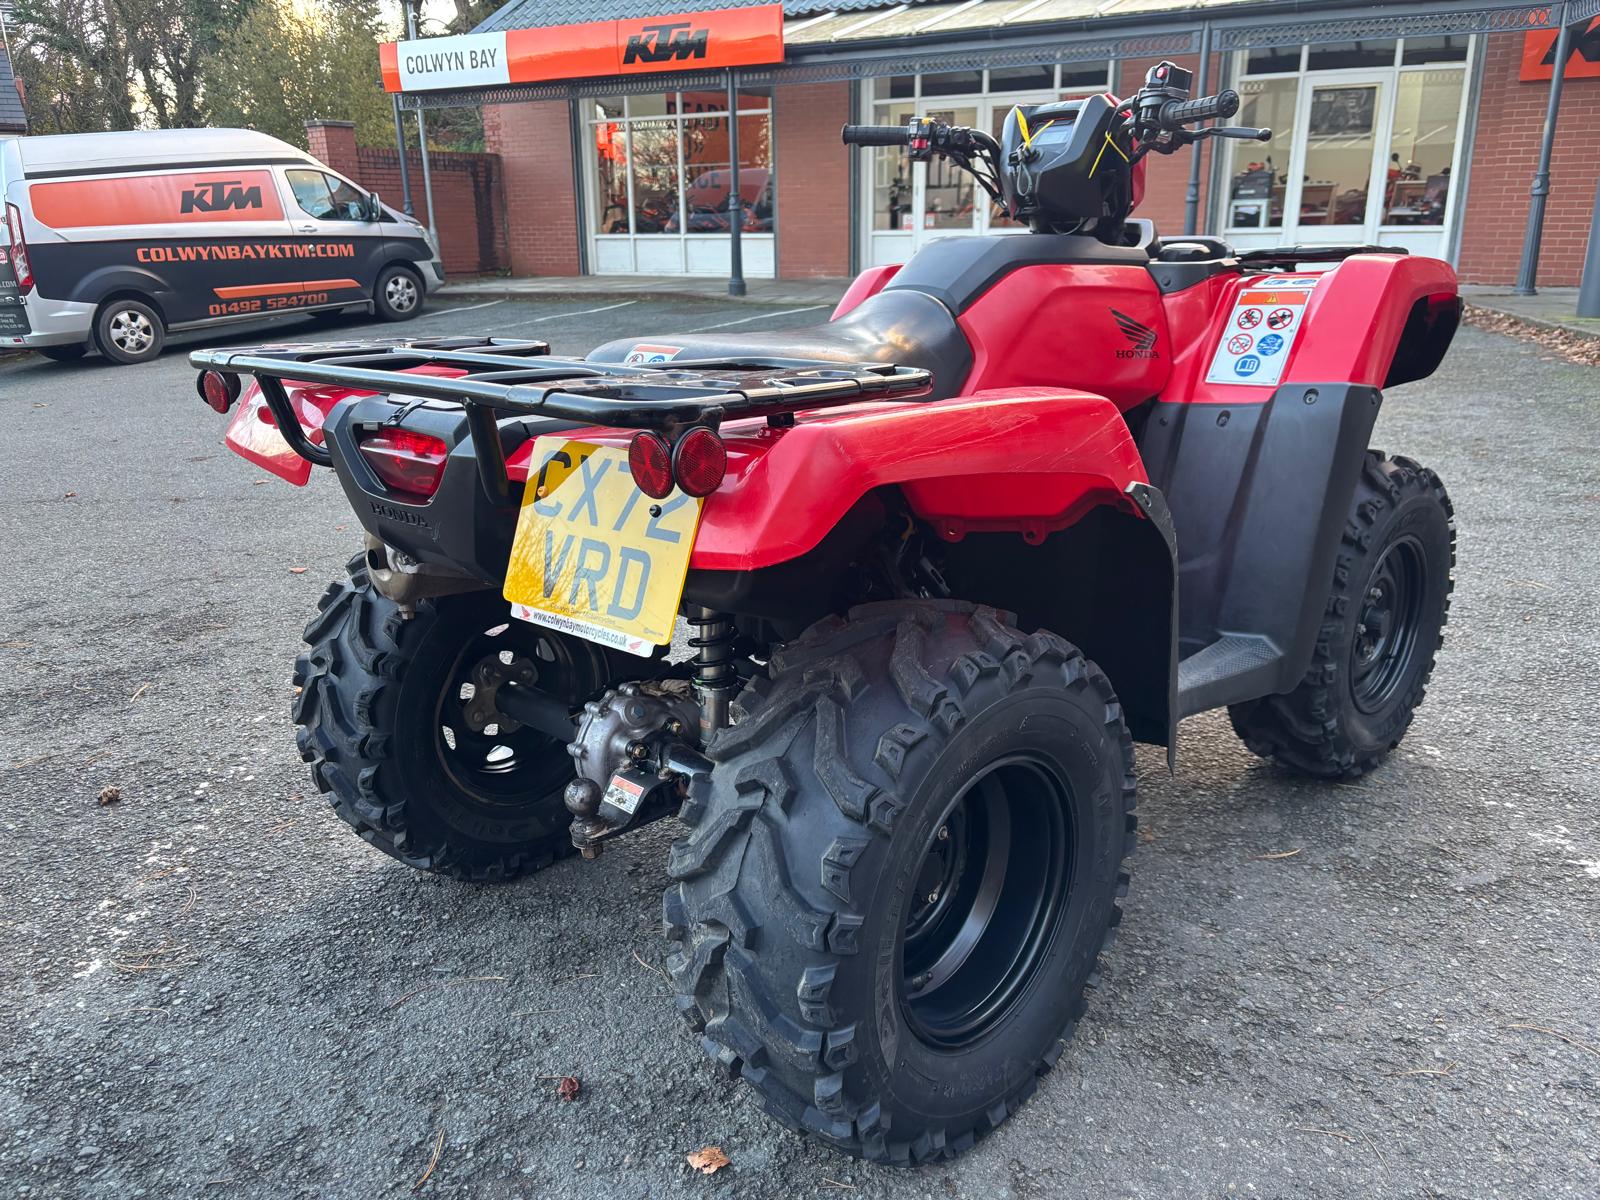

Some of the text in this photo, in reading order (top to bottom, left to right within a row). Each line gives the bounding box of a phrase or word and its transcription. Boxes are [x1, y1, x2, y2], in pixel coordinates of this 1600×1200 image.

[623, 22, 709, 65] KTM
[406, 48, 498, 74] COLWYN BAY
[180, 181, 263, 214] KTM
[137, 243, 355, 263] COLWYNBAYKTM.COM
[209, 293, 328, 316] 01492 524700
[1115, 350, 1160, 359] HONDA
[533, 450, 690, 544] CX72
[370, 501, 432, 529] HONDA
[544, 529, 652, 621] VRD
[533, 610, 628, 647] www.colwynbaymotorcycles.co.uk
